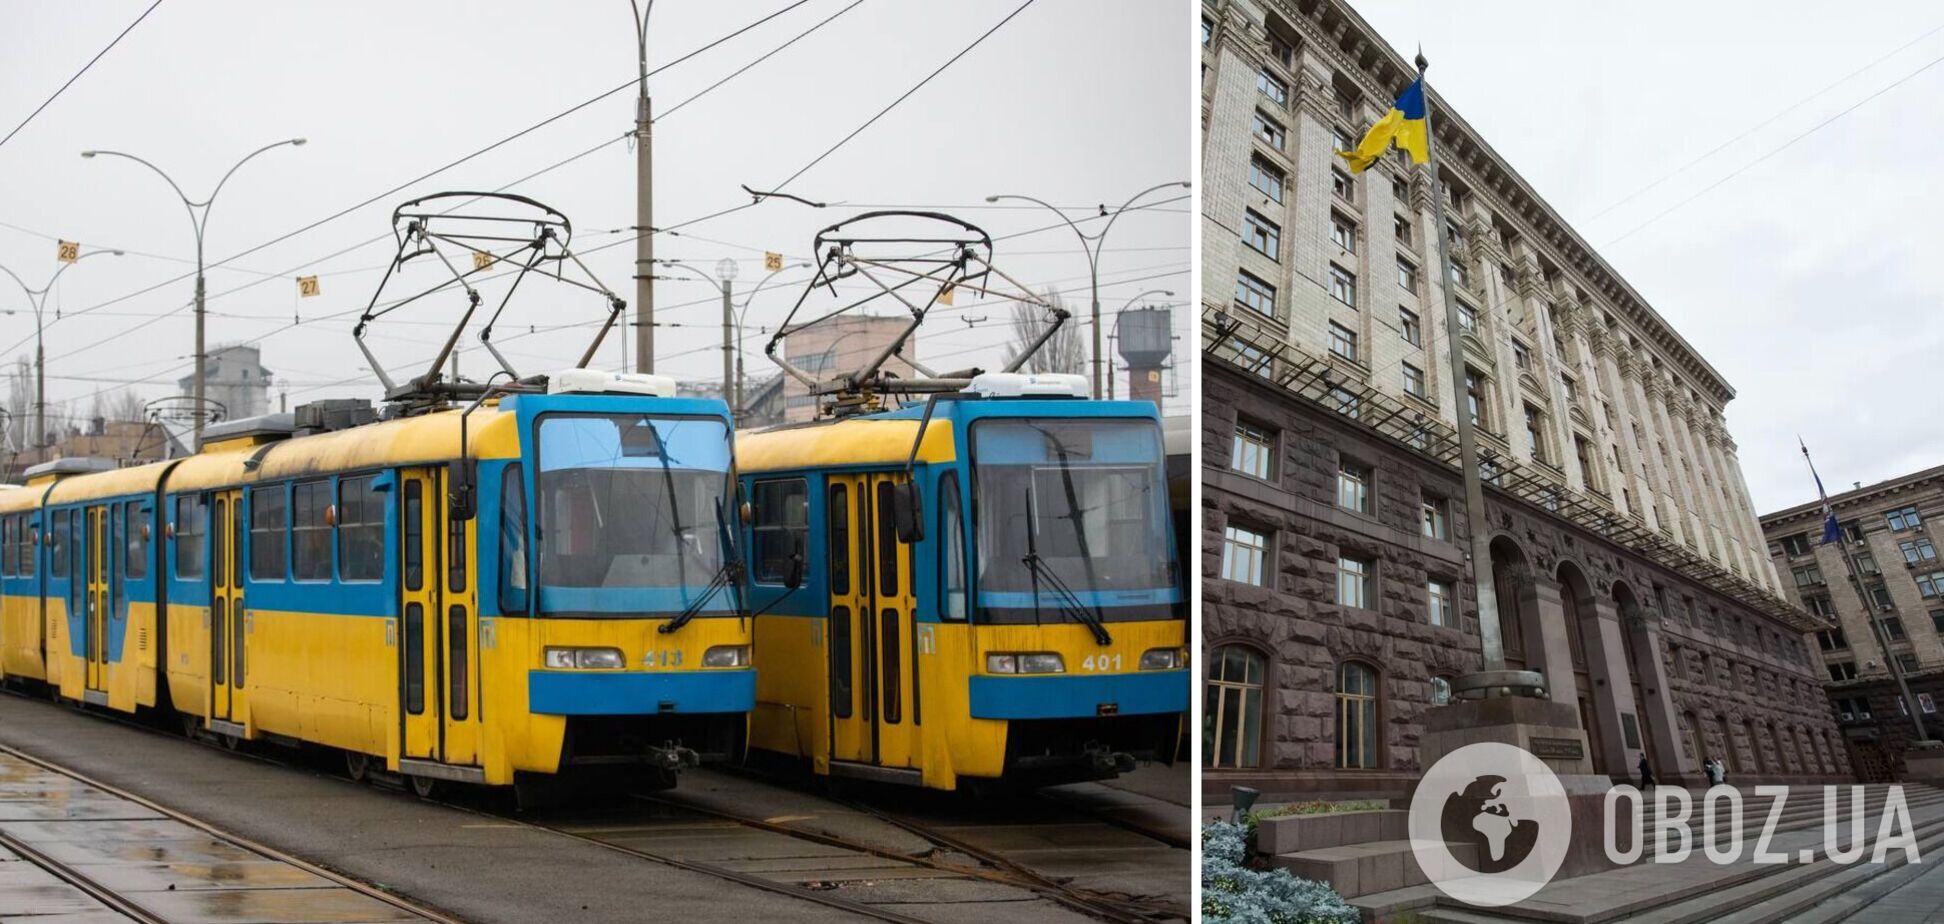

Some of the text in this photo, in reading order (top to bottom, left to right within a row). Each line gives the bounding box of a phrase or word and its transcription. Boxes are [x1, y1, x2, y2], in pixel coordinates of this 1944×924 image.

[61, 246, 78, 259] 28
[767, 256, 781, 269] 25
[302, 281, 317, 295] 27
[642, 650, 683, 667] 413
[1082, 654, 1122, 671] 401
